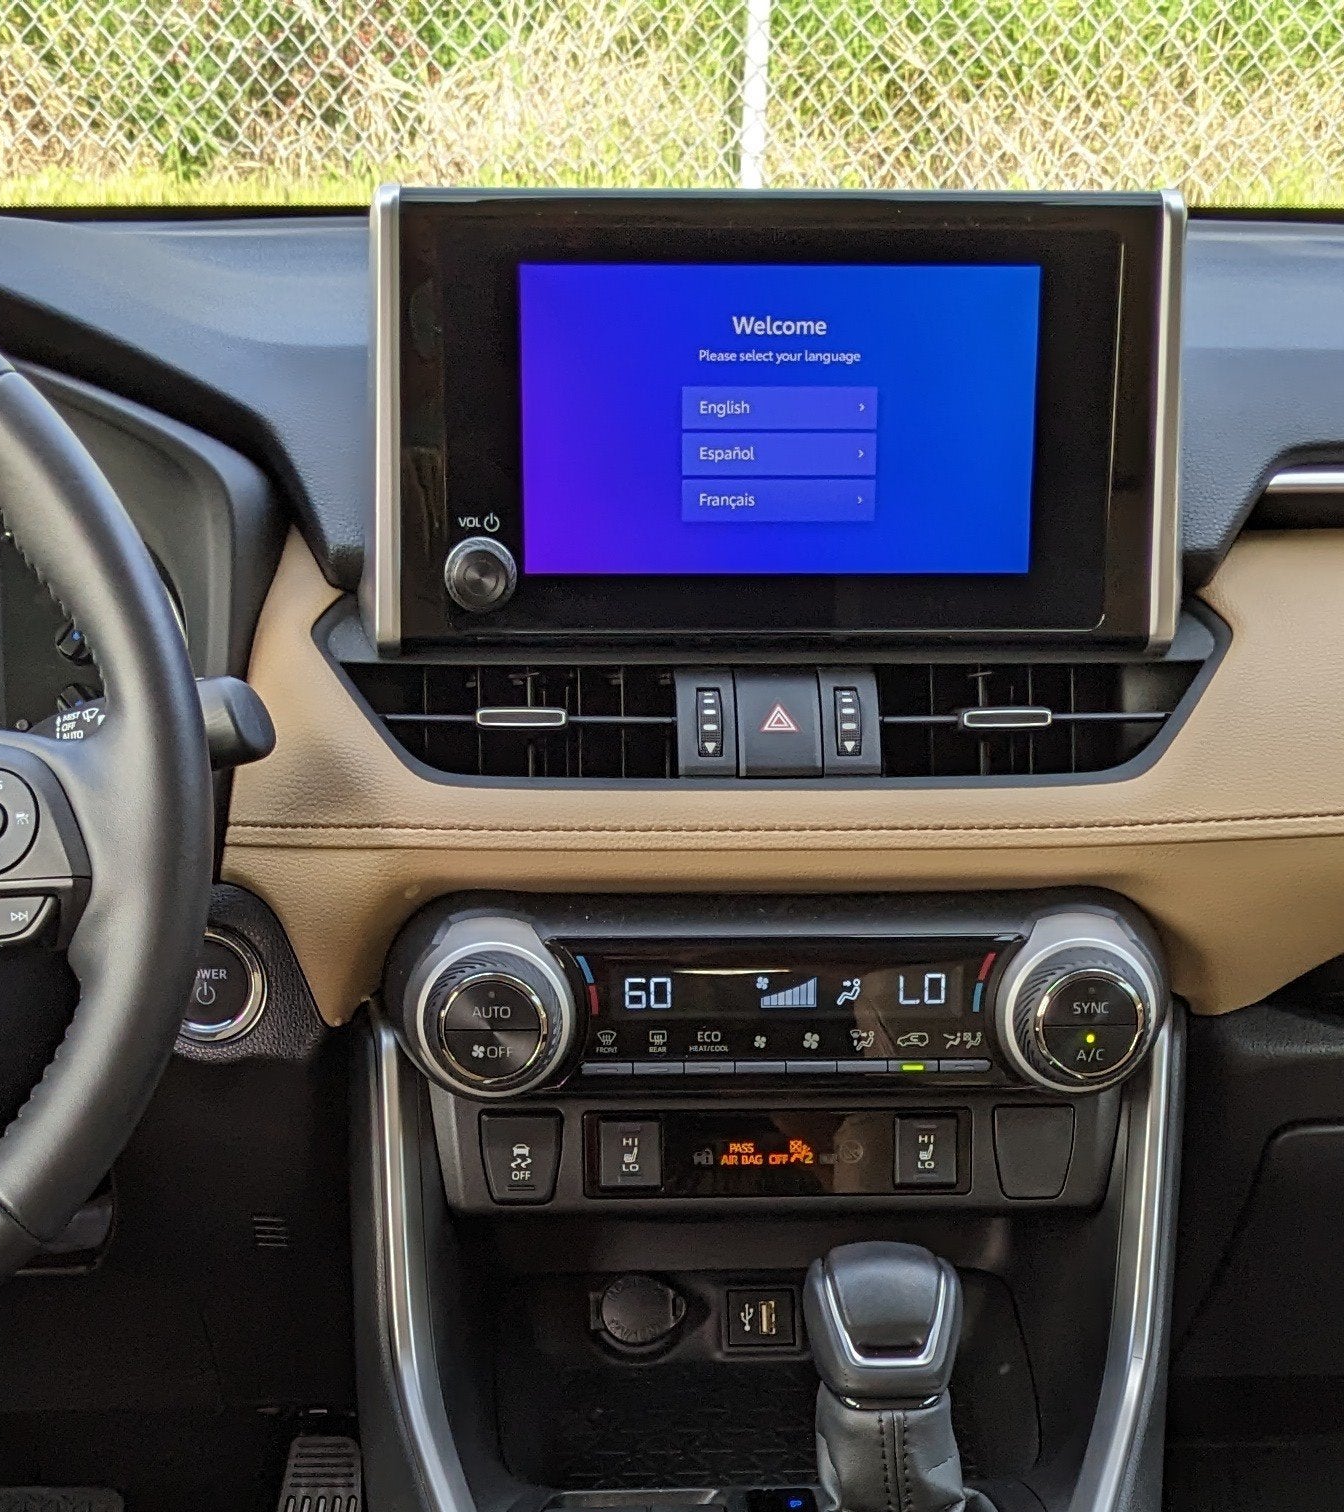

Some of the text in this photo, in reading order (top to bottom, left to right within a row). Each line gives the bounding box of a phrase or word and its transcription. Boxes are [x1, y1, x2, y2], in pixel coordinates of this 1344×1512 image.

[732, 315, 828, 336] Welcome
[699, 350, 862, 365] Please select your language
[699, 400, 751, 418] English
[699, 446, 755, 463] Español
[699, 493, 756, 510] Français
[458, 516, 482, 528] VOL
[62, 730, 84, 740] AUTO
[197, 968, 227, 980] WER
[624, 977, 673, 1009] 60
[898, 973, 947, 1005] LO
[472, 1005, 512, 1020] AUTO
[1072, 1001, 1110, 1015] SYNC
[697, 1031, 721, 1043] ECO
[486, 1046, 513, 1059] OFF
[595, 1046, 619, 1054] FRONT
[649, 1046, 667, 1054] REAR
[688, 1045, 729, 1053] HEAT/COOL
[1076, 1049, 1105, 1062] A/C
[622, 1137, 639, 1147] HI
[918, 1134, 935, 1144] HI
[729, 1143, 754, 1154] PASS
[720, 1154, 738, 1165] AIR
[768, 1154, 789, 1165] OFF
[917, 1160, 935, 1169] LO
[622, 1163, 640, 1172] LO
[511, 1170, 531, 1181] OFF
